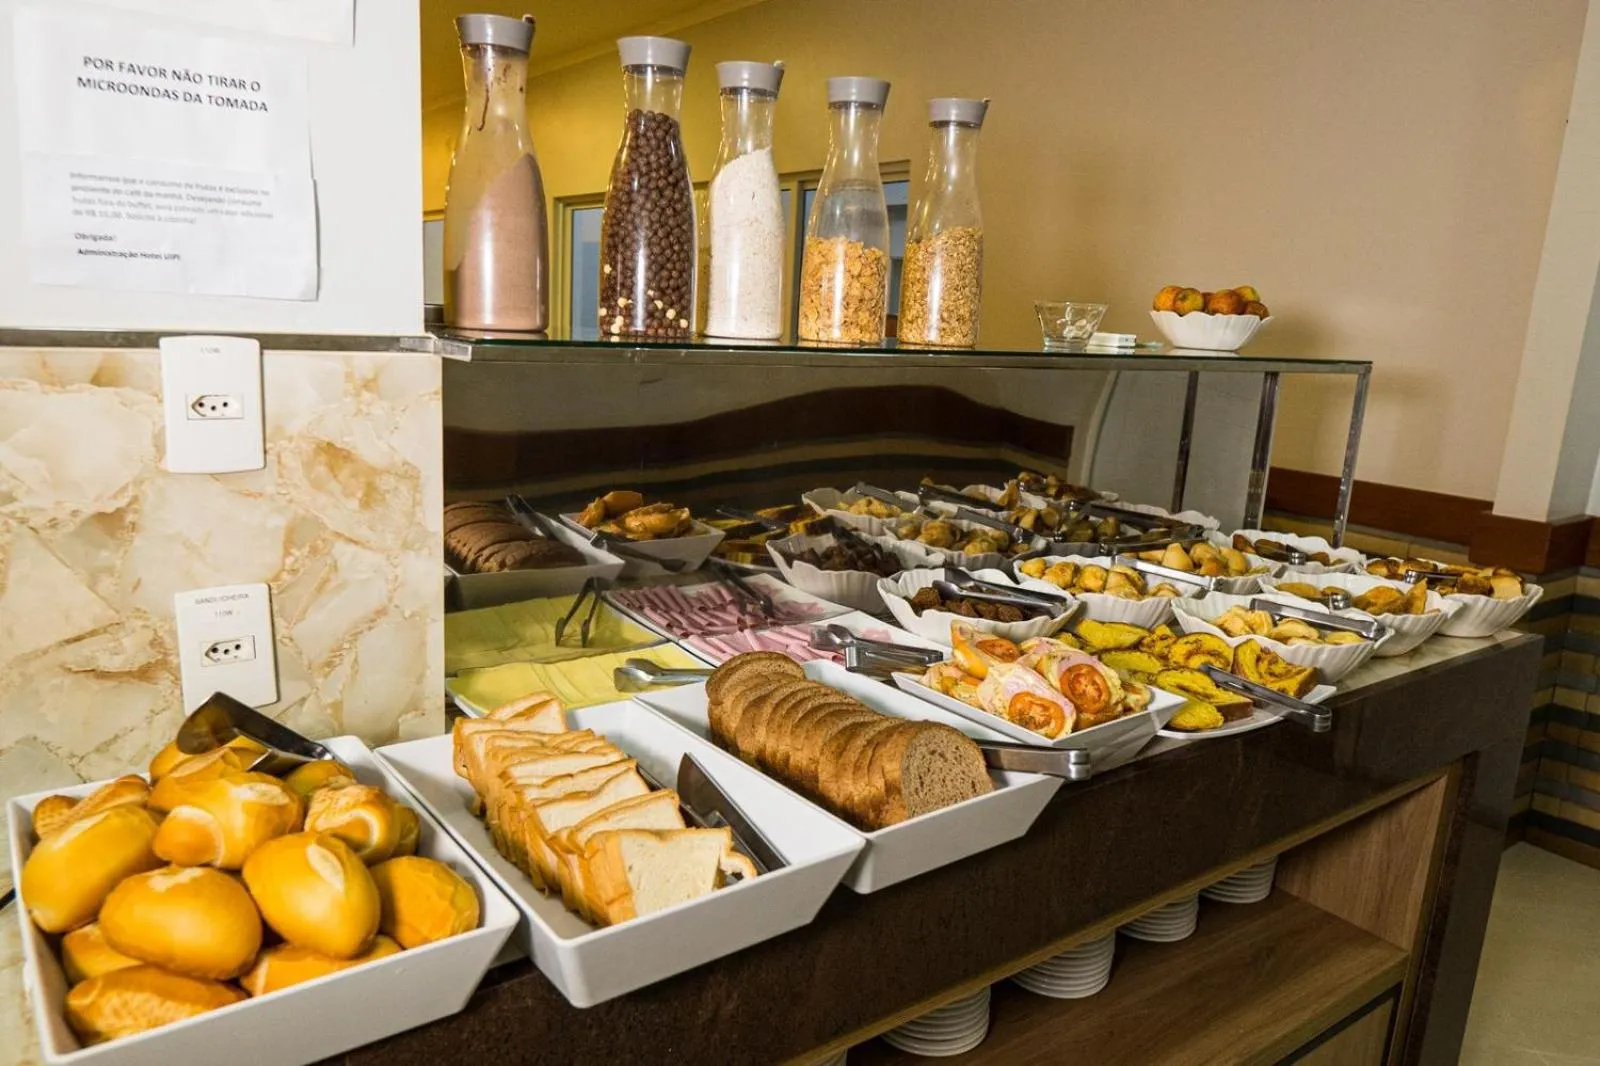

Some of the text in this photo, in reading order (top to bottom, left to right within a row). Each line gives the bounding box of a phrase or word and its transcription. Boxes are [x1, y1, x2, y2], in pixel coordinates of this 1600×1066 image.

[83, 55, 261, 92] POR FAVOR NÃO TIRAR O
[77, 76, 269, 113] MICROONDAS DA TOMADA
